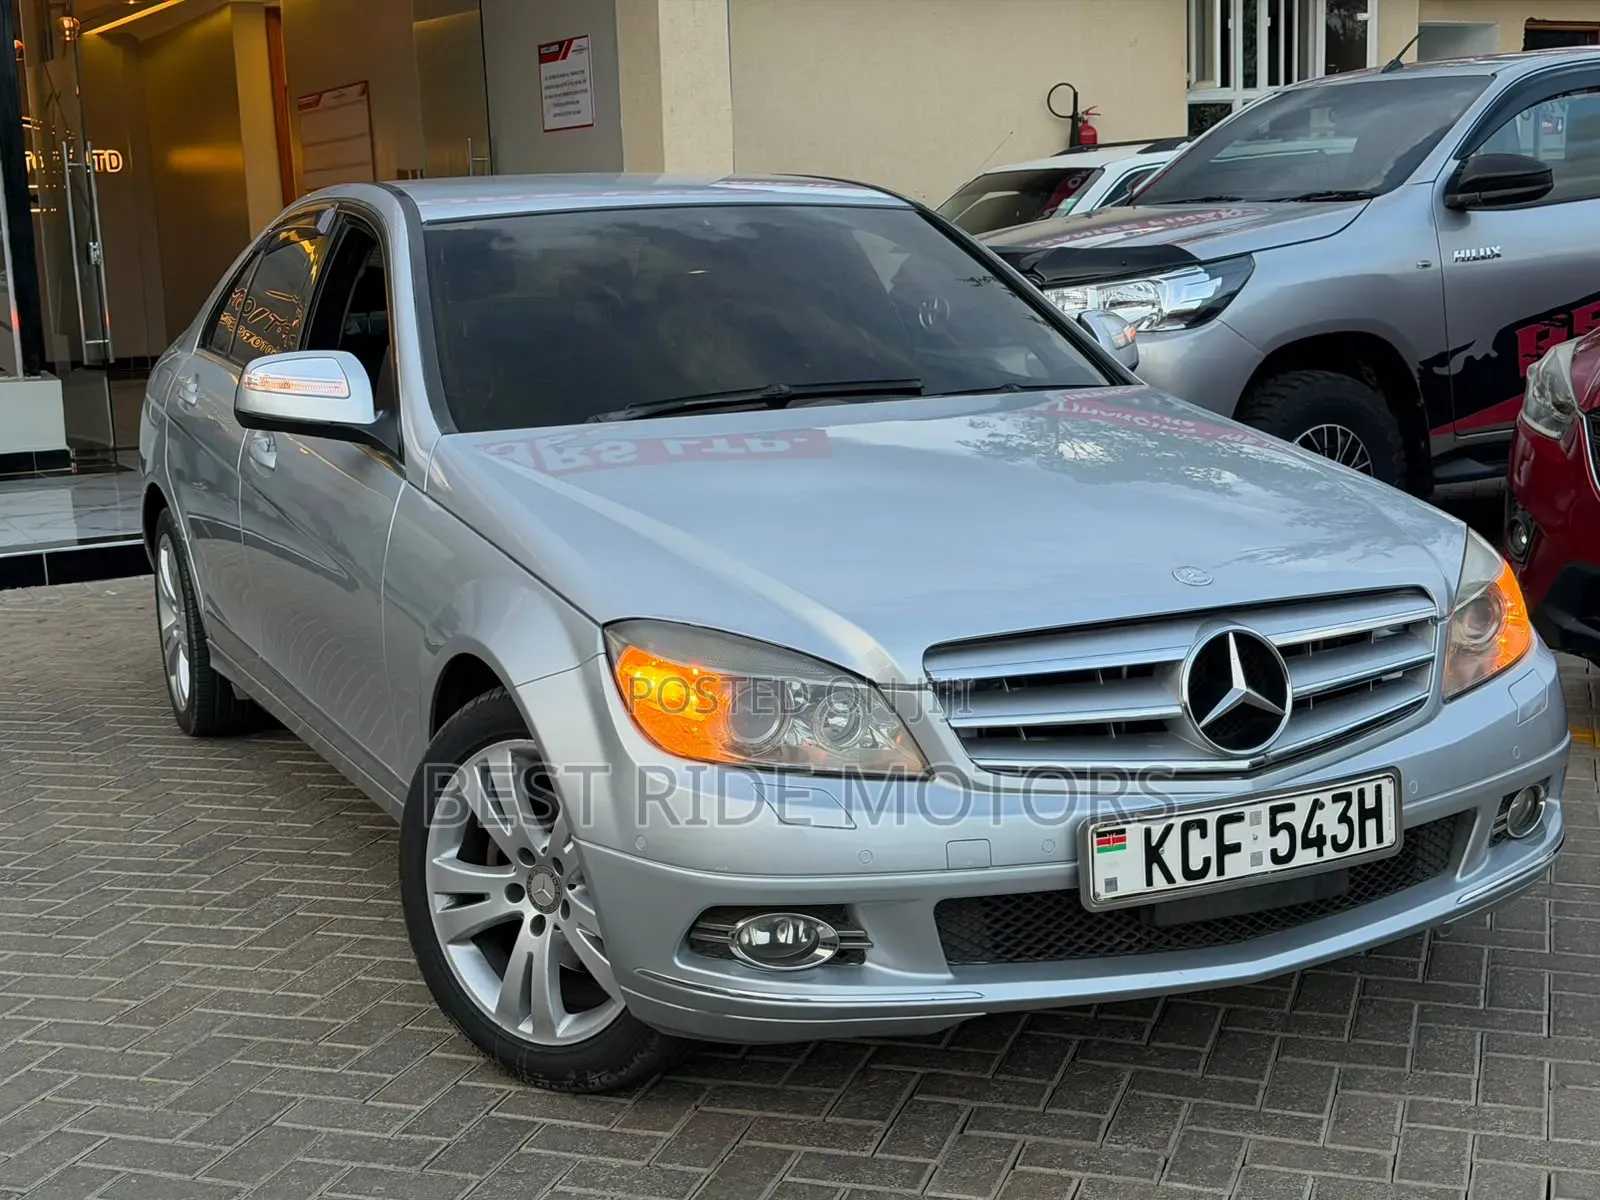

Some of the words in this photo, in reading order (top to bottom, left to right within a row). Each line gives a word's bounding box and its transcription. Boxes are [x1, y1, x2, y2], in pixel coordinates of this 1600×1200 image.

[1453, 245, 1502, 262] HILUX
[1144, 811, 1245, 887] KCF
[1268, 783, 1384, 866] 543H
